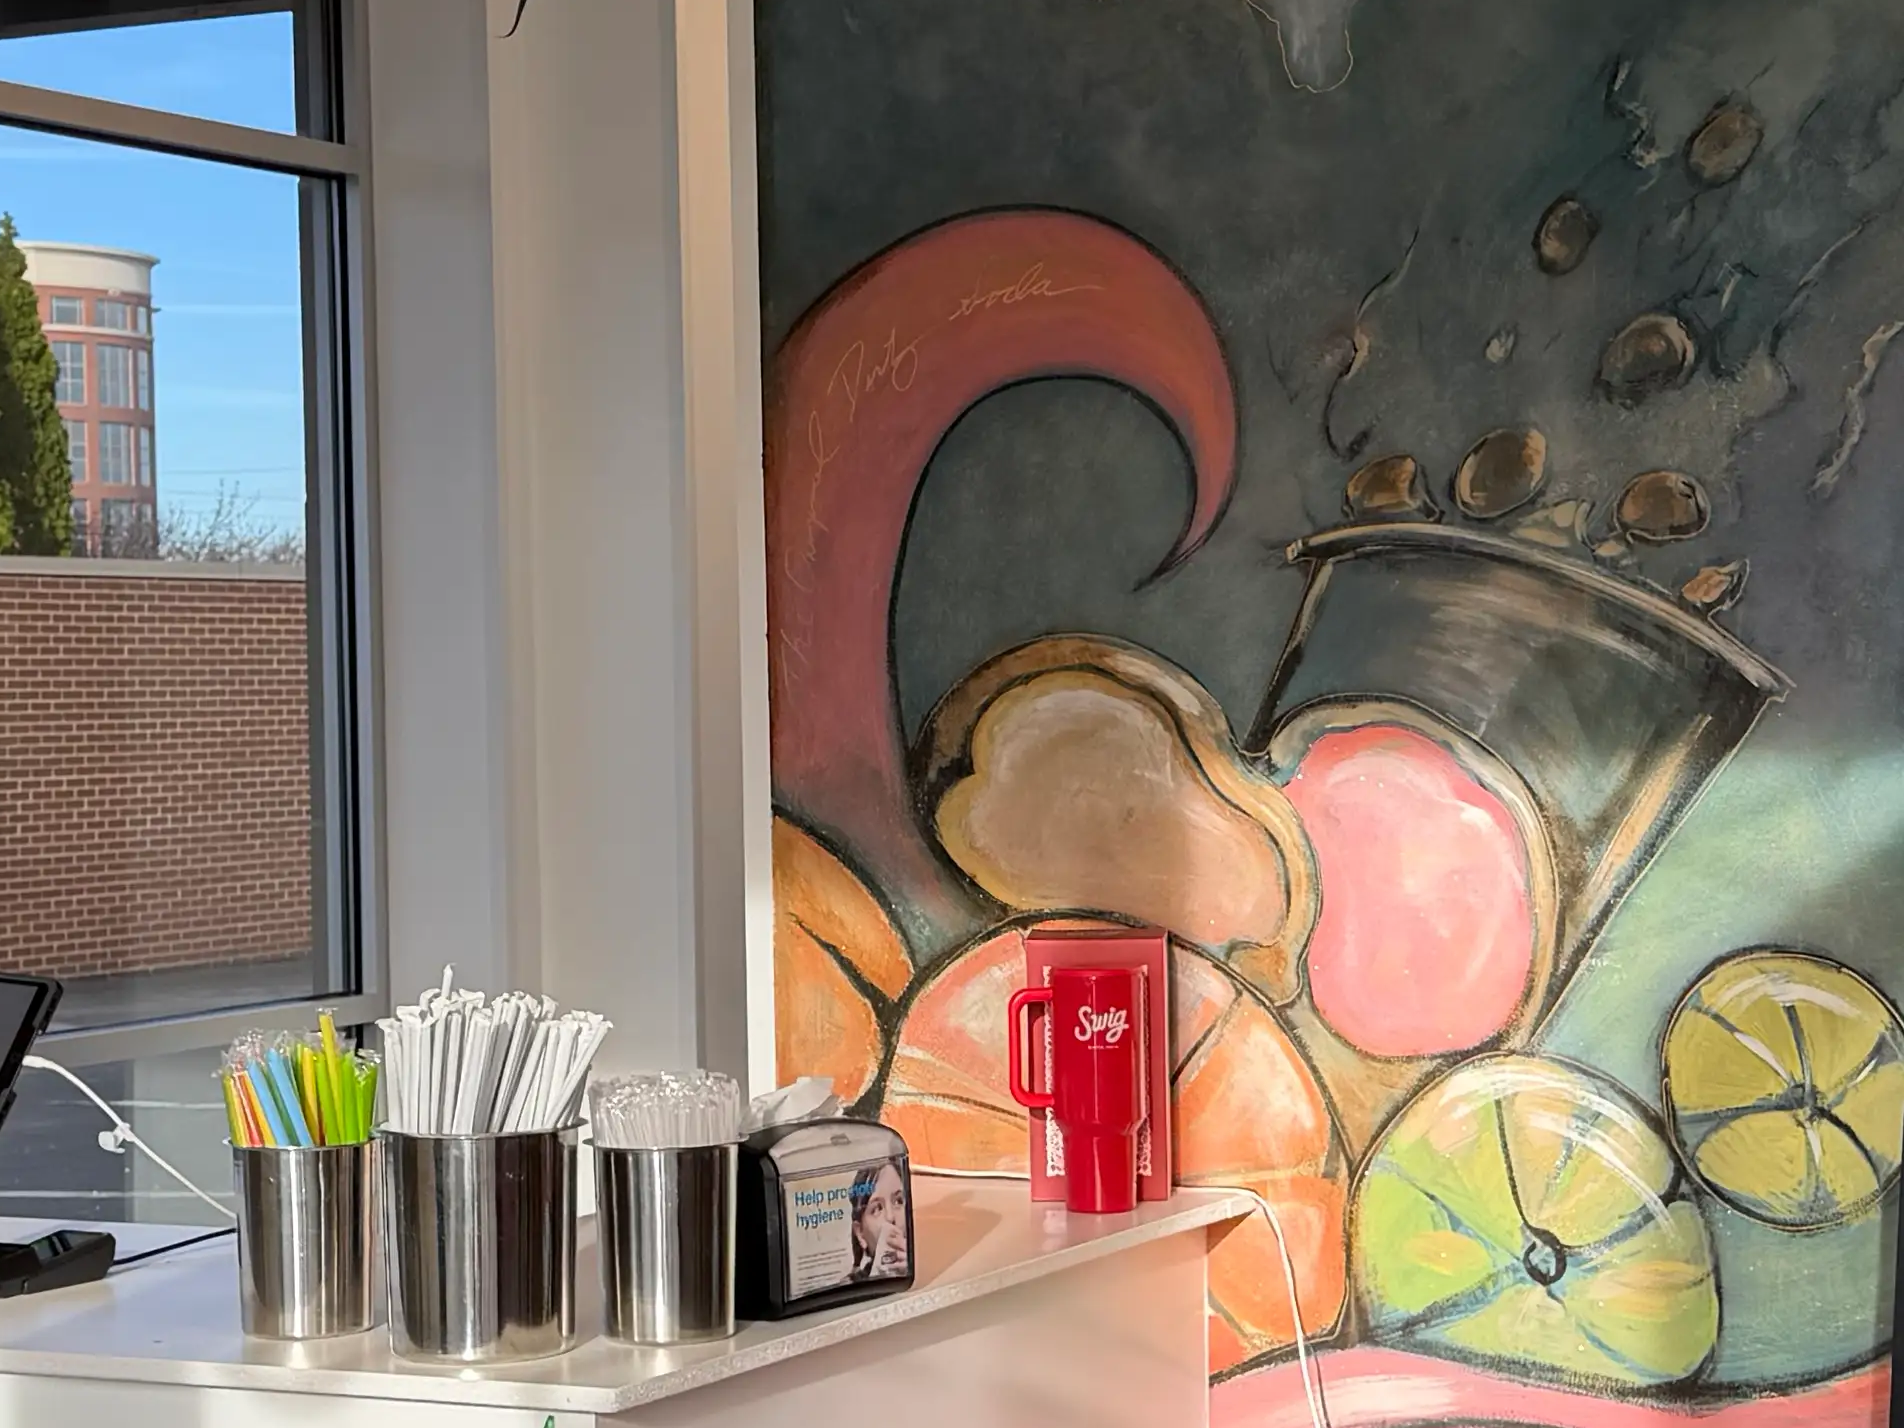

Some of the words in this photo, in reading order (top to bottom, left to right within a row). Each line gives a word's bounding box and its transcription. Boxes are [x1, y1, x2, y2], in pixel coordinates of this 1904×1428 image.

[1074, 1005, 1130, 1043] Swig
[794, 1188, 824, 1207] Help
[796, 1209, 844, 1229] hygiene
